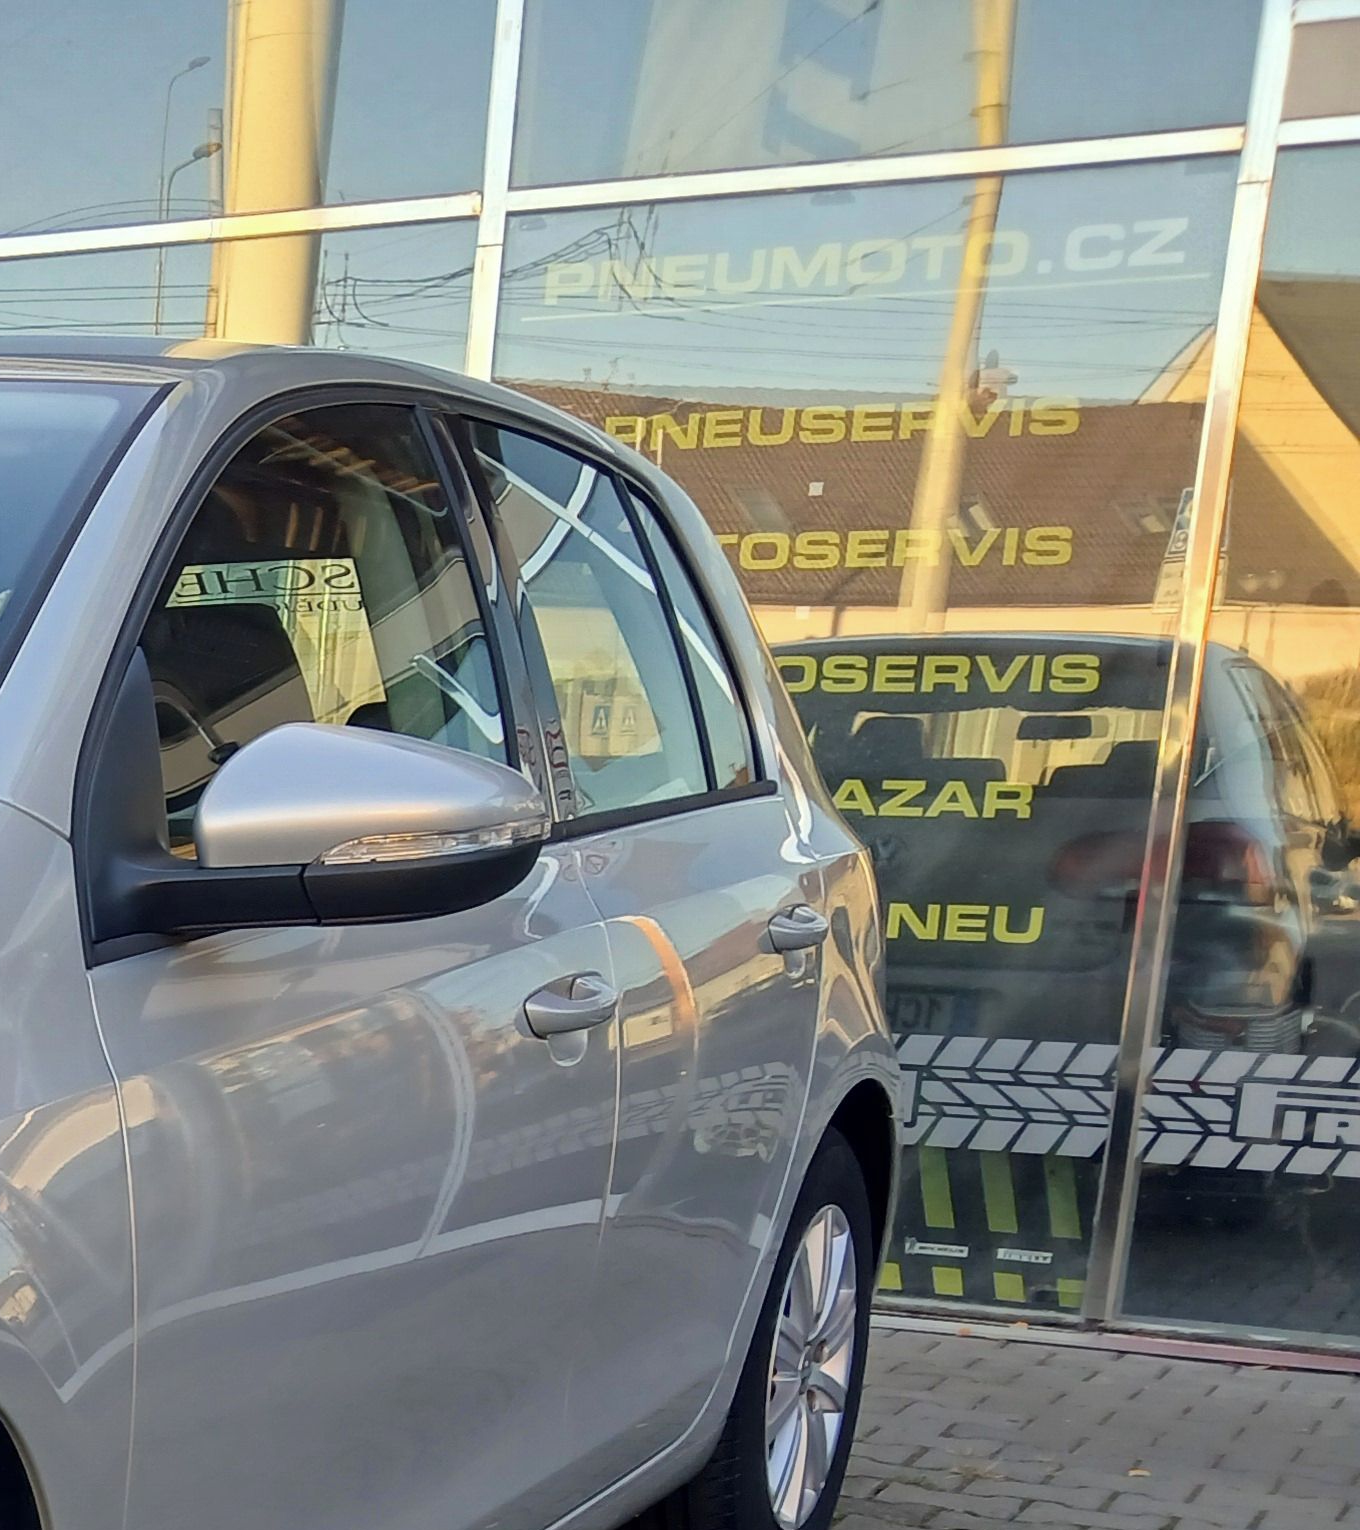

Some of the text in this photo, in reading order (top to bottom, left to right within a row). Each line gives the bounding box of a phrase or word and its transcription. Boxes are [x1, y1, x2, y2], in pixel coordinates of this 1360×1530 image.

[543, 217, 1189, 306] PNEUMOTO.CZ
[604, 395, 1081, 452] PNEUSERVIS
[714, 526, 1074, 571] OSERVIS
[771, 654, 1101, 694] OSERVIS
[831, 778, 1035, 819] AZAR
[885, 902, 1045, 944] NEU
[1235, 1081, 1360, 1147] PIR
